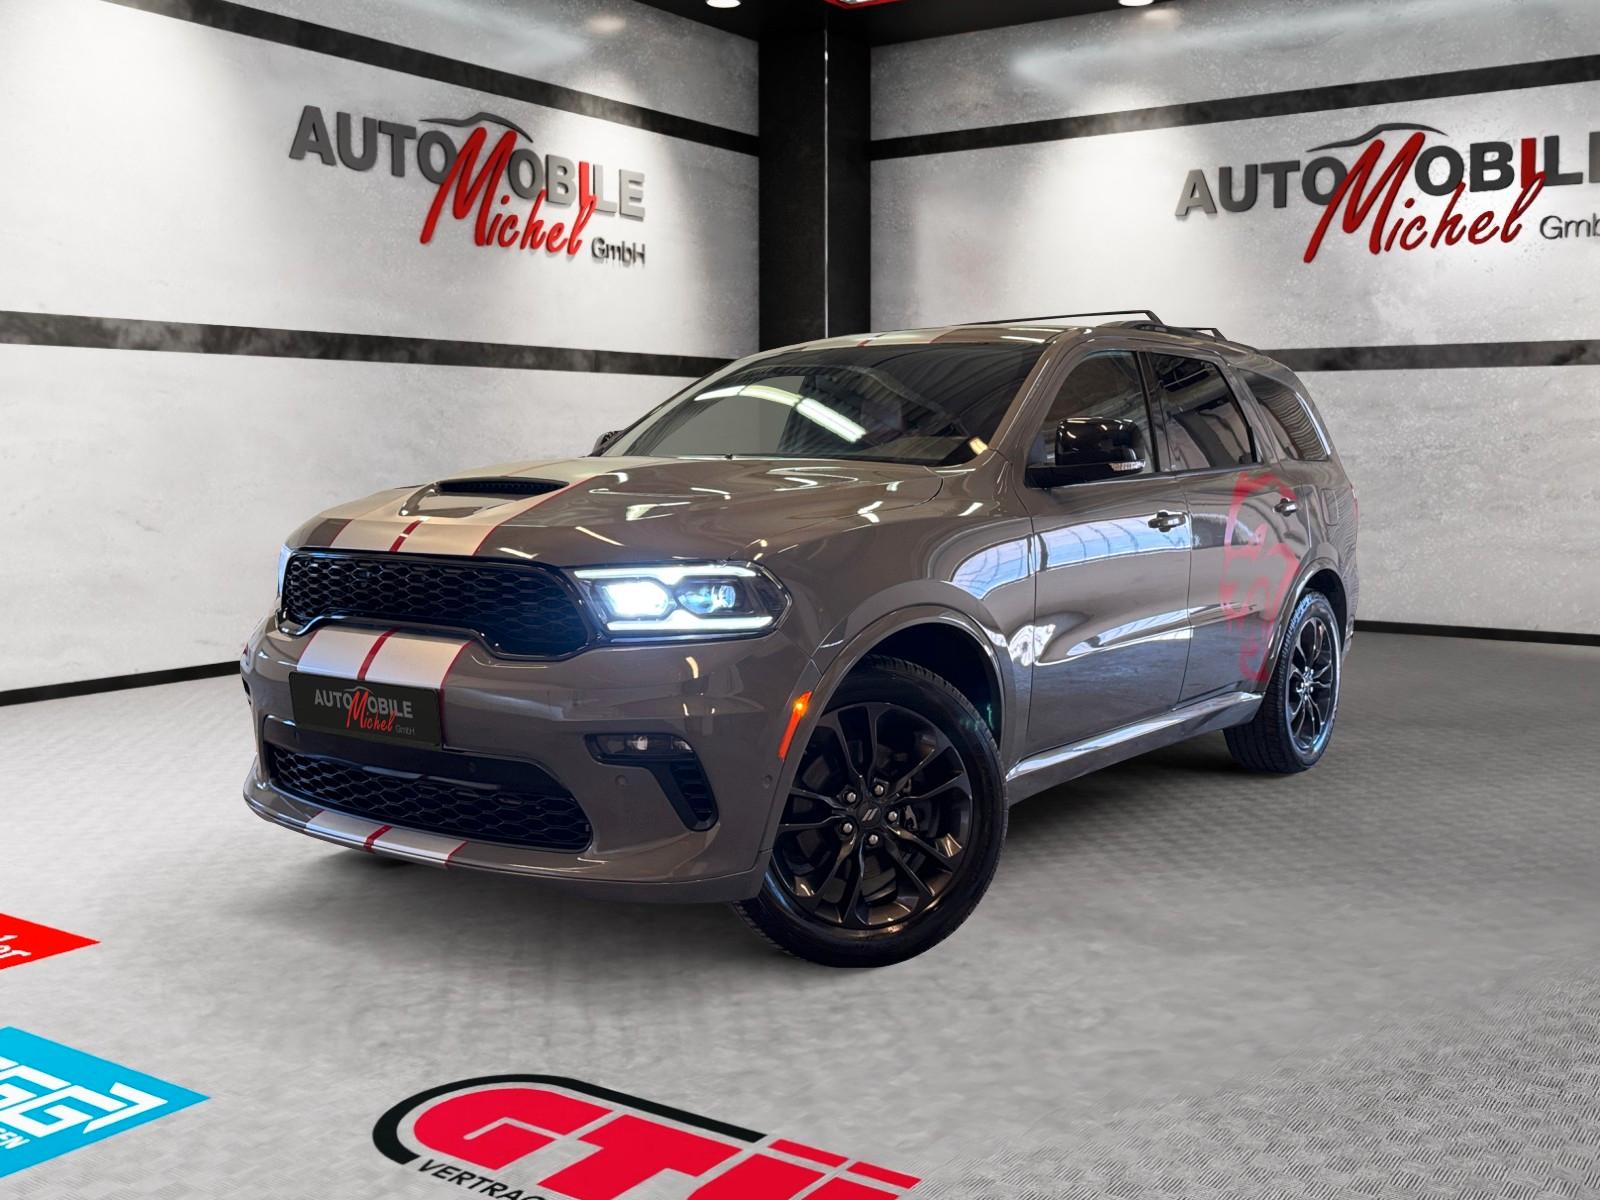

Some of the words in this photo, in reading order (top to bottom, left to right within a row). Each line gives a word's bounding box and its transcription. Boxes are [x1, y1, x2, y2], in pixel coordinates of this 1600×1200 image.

[419, 127, 597, 256] Michel
[1303, 132, 1546, 263] Michel
[591, 236, 646, 265] GmbH
[346, 690, 397, 733] Michel
